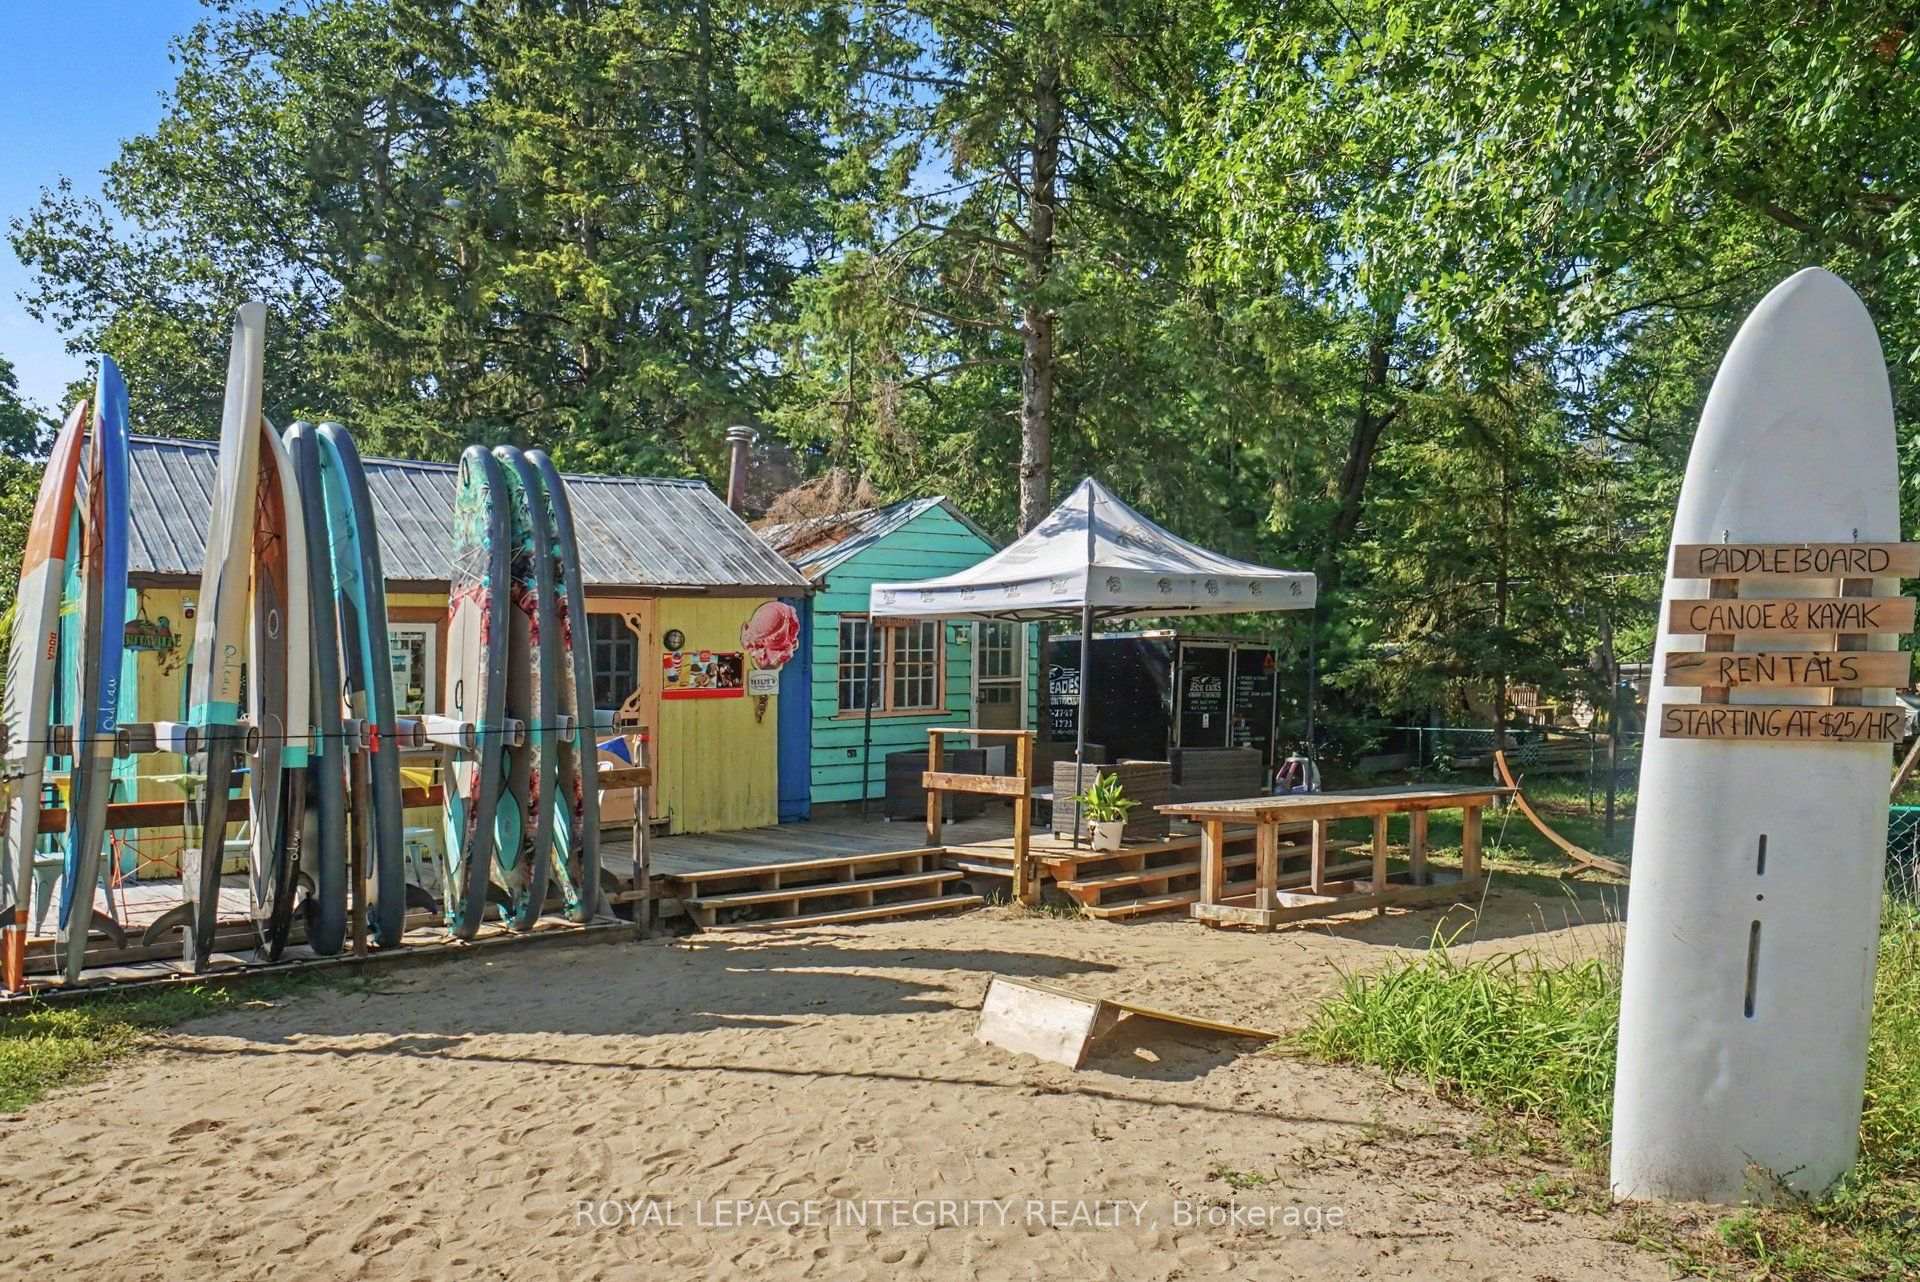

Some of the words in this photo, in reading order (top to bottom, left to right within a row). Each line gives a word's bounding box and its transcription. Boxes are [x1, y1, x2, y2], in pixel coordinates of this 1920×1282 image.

[1699, 547, 1889, 574] PADDLEBOARD
[1689, 603, 1776, 631] CANOE
[1780, 602, 1798, 629] &
[1807, 603, 1881, 629] KAYAK
[1719, 655, 1858, 682] RENTALS
[1665, 708, 1784, 737] STARTING
[1785, 710, 1818, 737] AT
[1818, 711, 1900, 740] $25/HR
